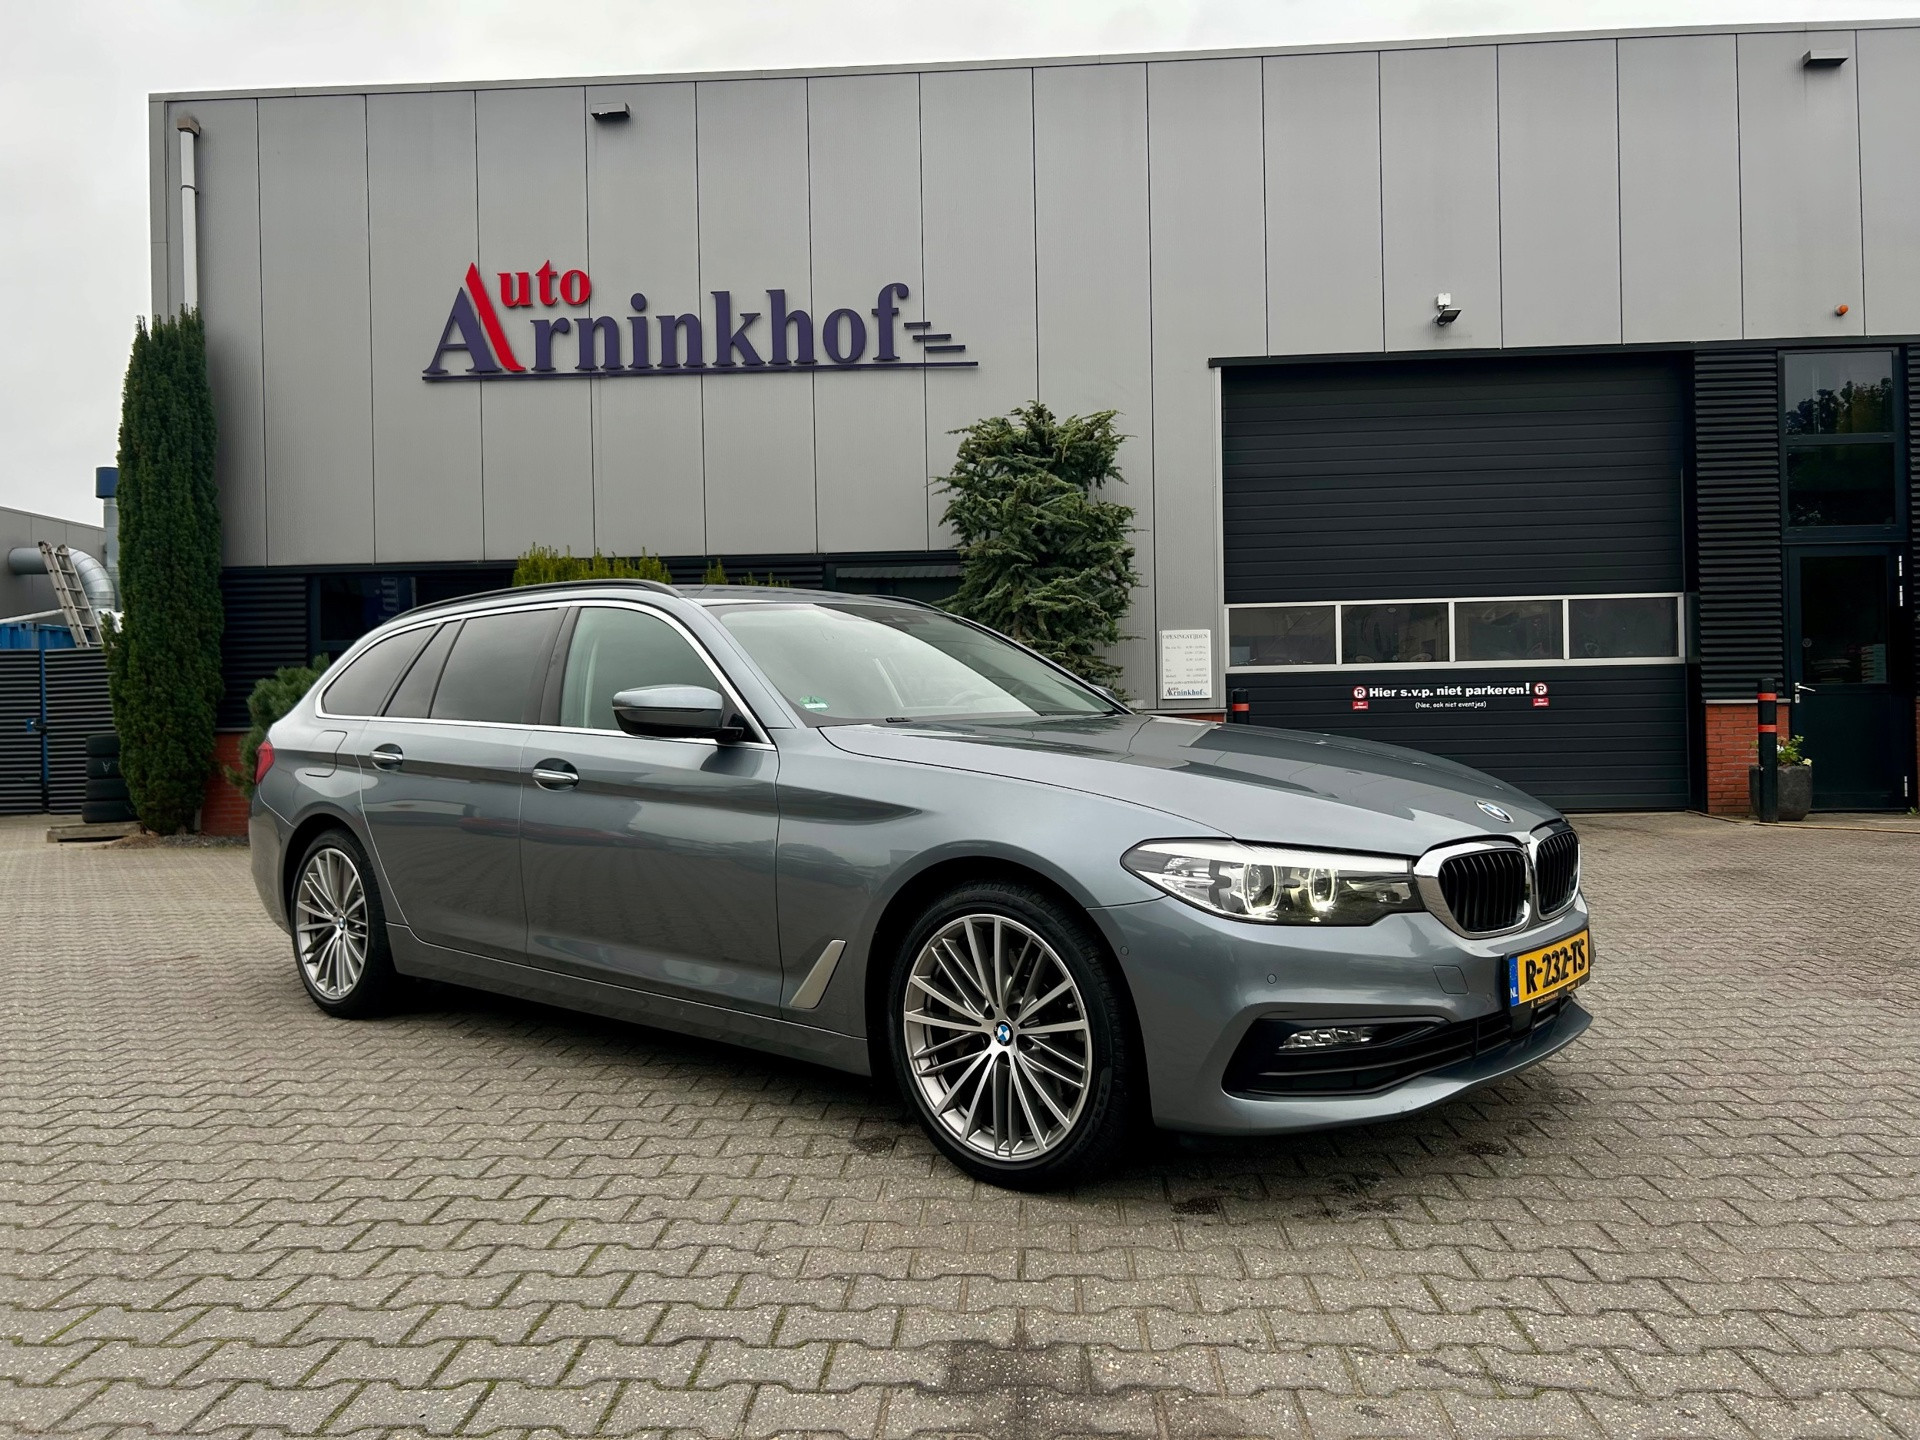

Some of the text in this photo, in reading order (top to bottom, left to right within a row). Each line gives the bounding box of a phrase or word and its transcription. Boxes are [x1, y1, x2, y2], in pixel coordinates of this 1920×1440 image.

[422, 282, 909, 374] Arninkhof
[1369, 682, 1530, 699] Hier s.v.p. niet parkeren!
[1526, 939, 1585, 994] R-232-TS
[1510, 987, 1518, 999] NL
